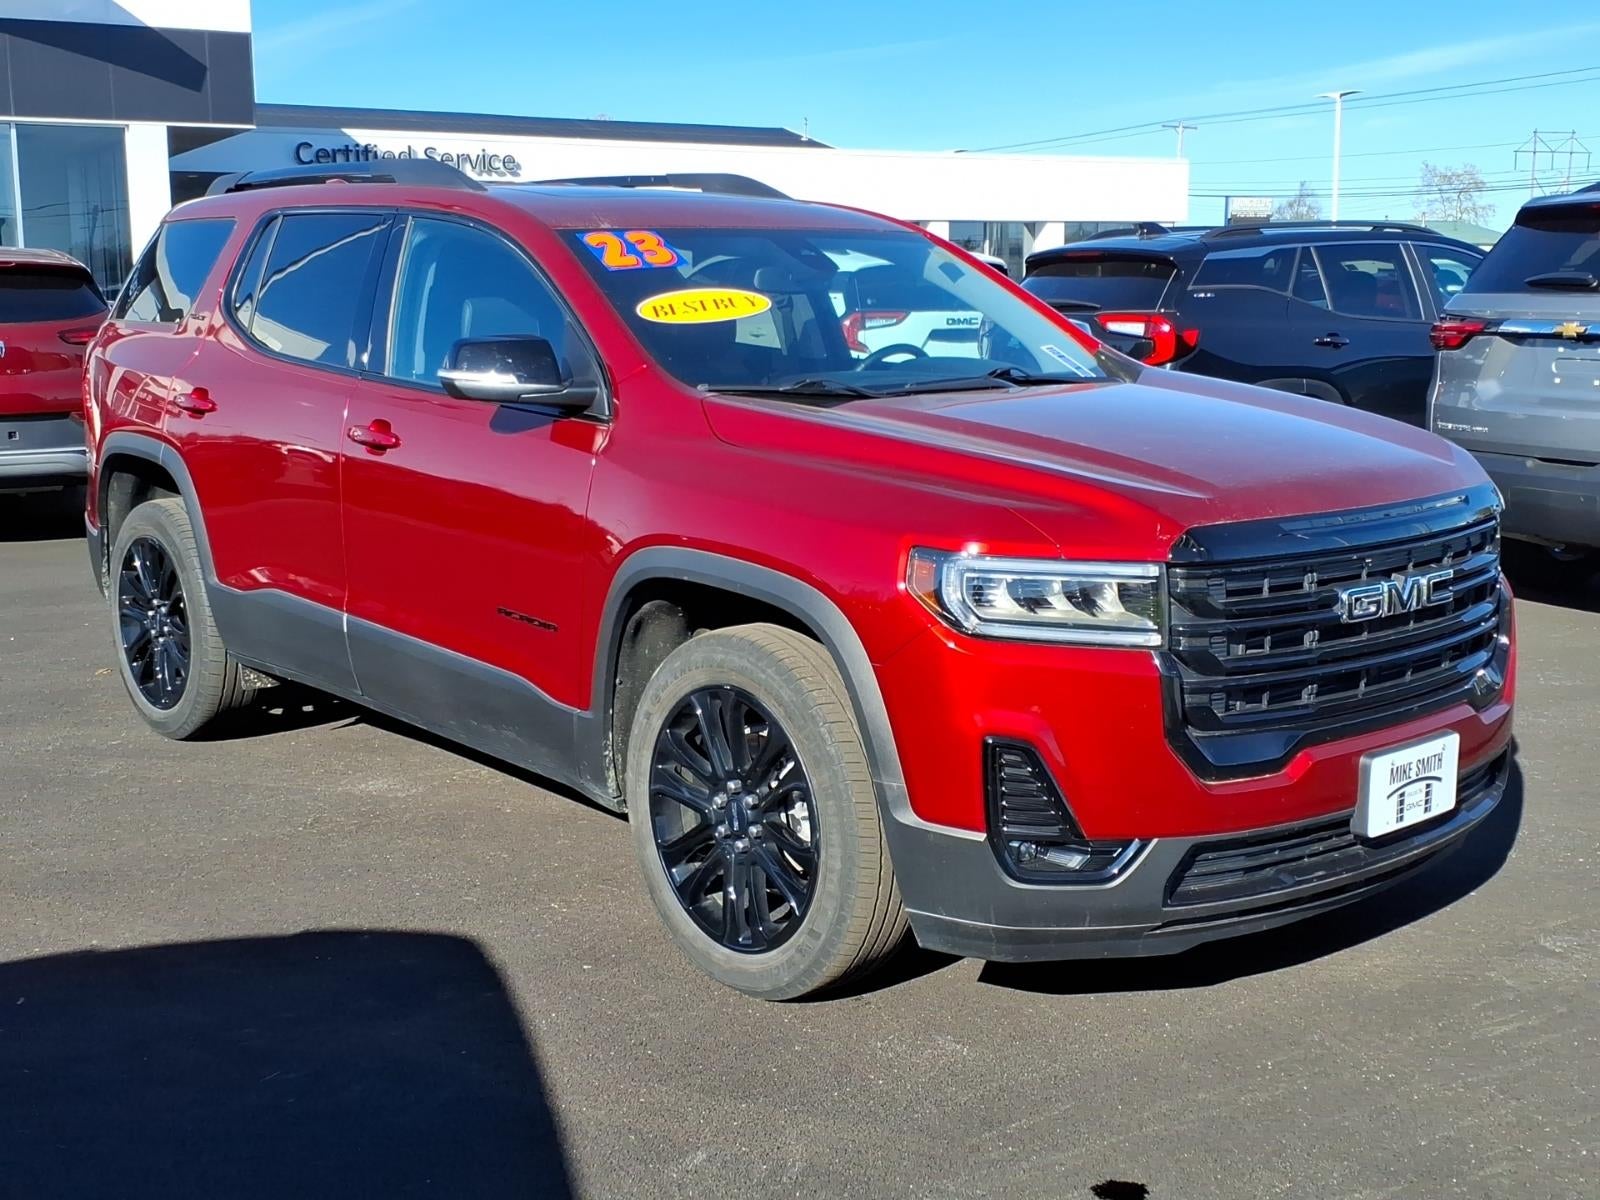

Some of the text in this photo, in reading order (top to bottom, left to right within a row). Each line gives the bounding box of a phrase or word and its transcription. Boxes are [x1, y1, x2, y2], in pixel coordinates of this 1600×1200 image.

[424, 147, 516, 171] Service
[583, 231, 678, 268] 23
[652, 295, 758, 318] BEST BUY
[946, 317, 979, 326] GMC
[1341, 569, 1454, 623] GMC
[1389, 752, 1443, 786] MIKE SMITH
